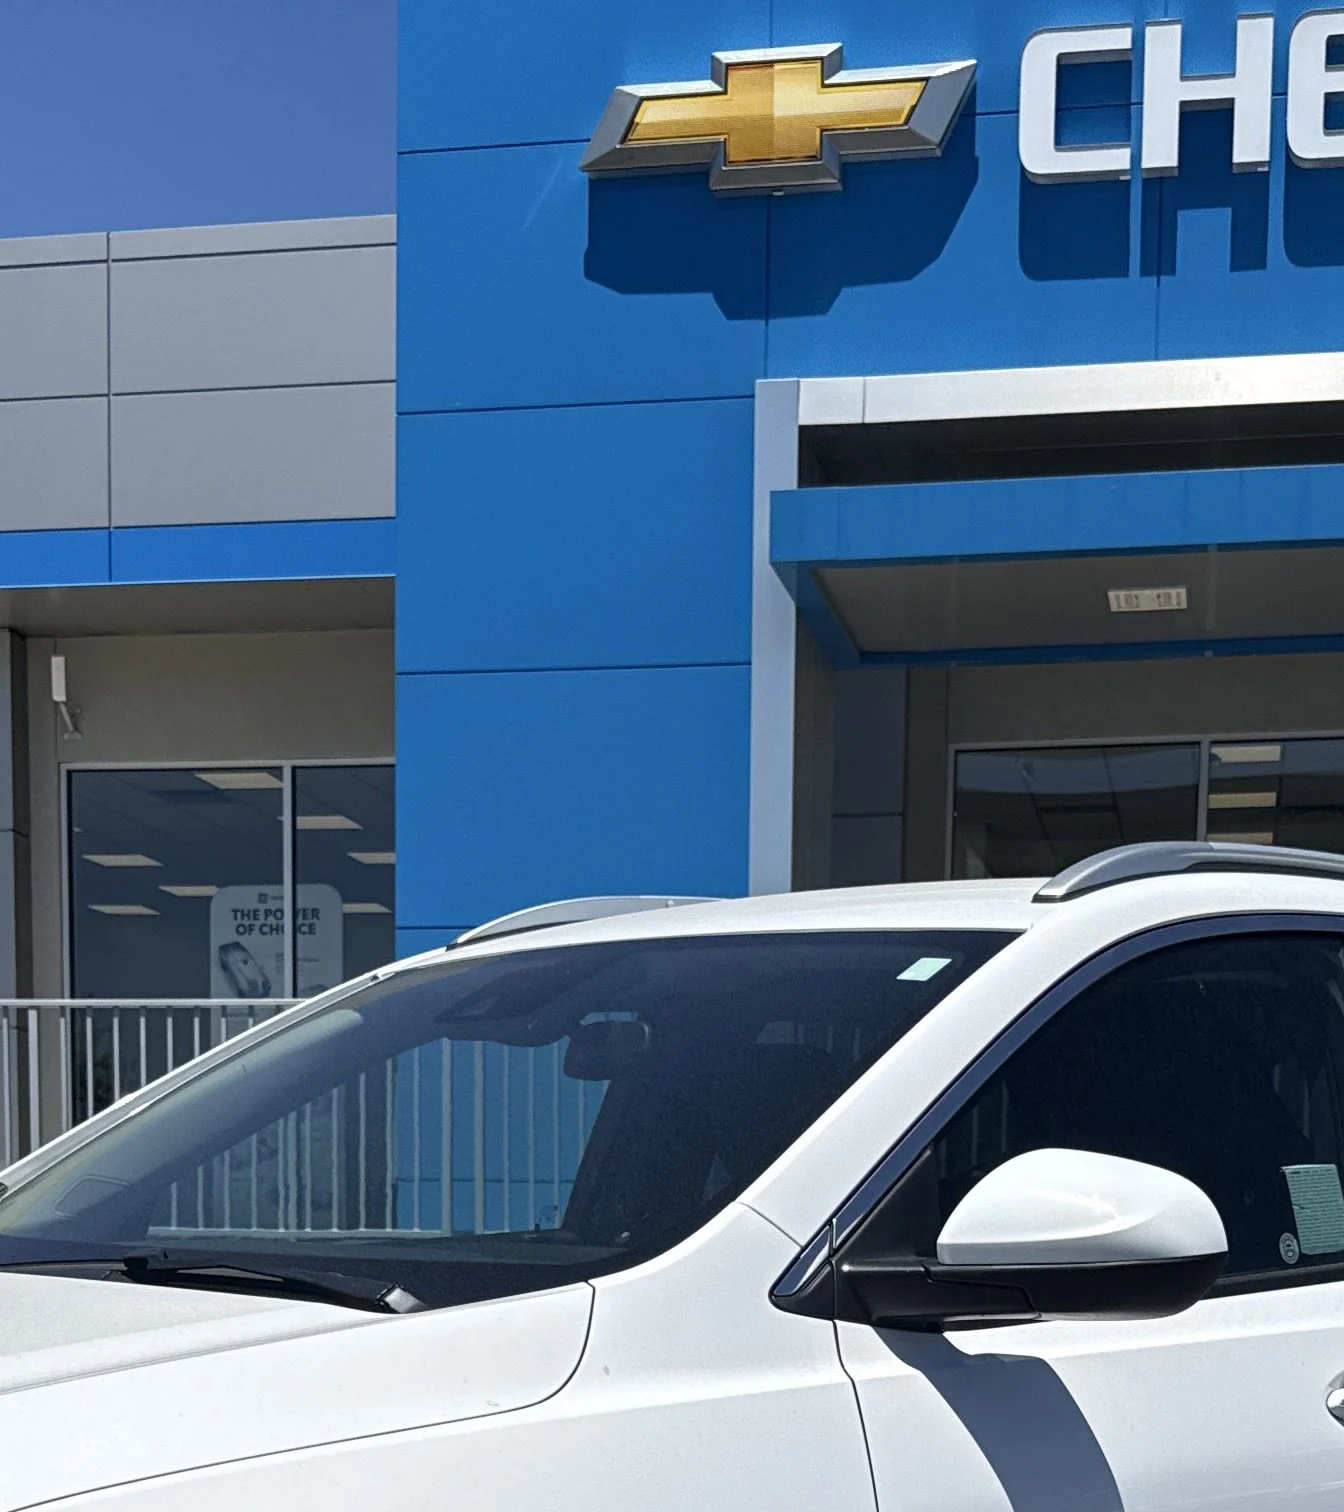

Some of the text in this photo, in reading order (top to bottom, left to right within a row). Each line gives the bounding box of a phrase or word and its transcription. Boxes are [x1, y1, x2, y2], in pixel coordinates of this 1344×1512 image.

[231, 907, 261, 922] THE
[235, 923, 317, 936] OF CHCE
